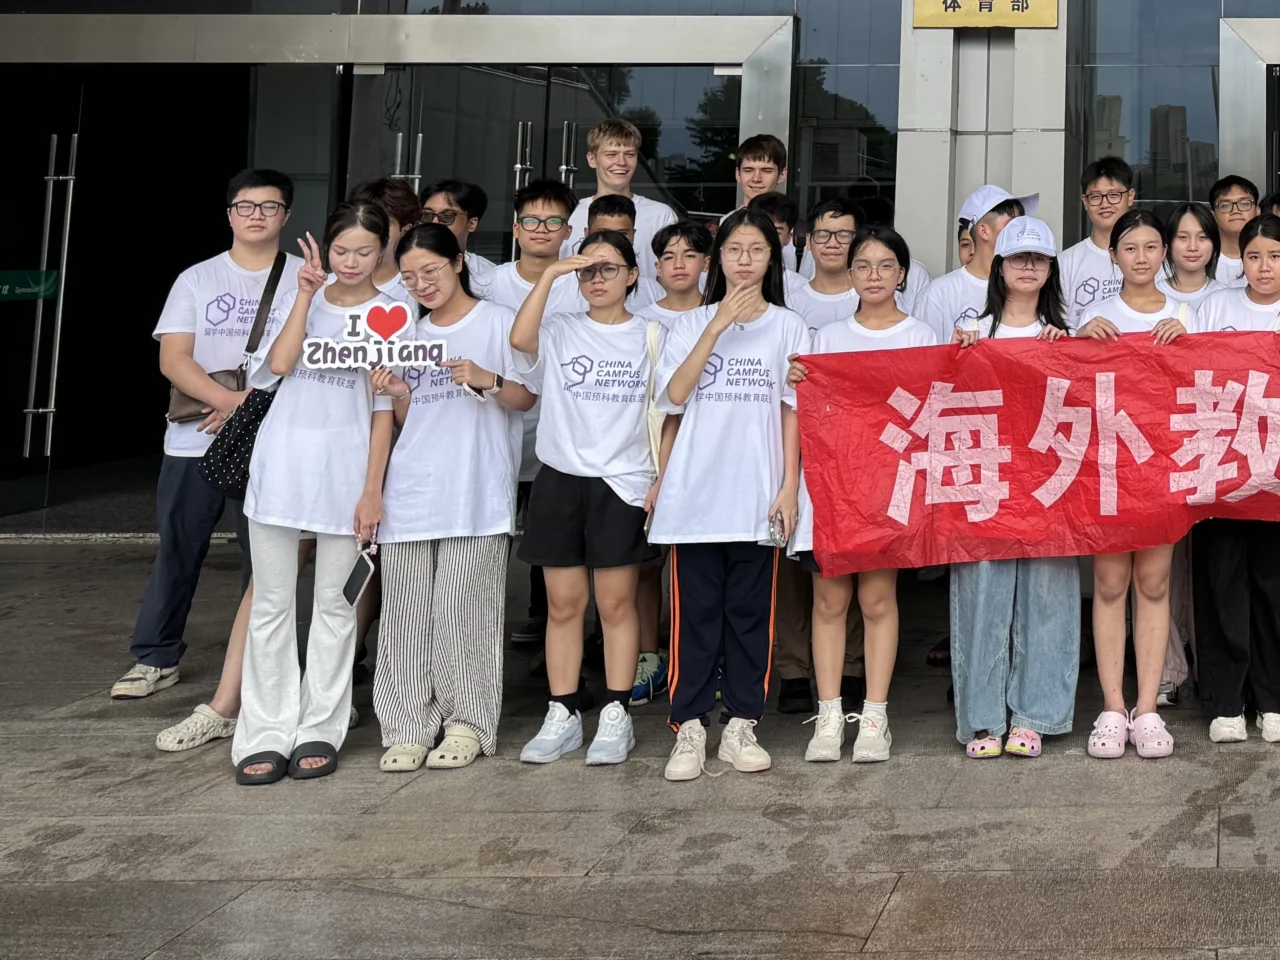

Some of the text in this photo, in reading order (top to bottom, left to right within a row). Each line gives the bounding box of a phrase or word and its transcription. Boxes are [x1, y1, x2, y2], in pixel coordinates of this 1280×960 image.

[1102, 279, 1122, 287] CHIN
[239, 298, 261, 306] CHIN
[347, 314, 361, 337] I
[307, 341, 444, 366] Zhenjiang
[598, 360, 632, 368] CHINA
[727, 358, 762, 366] CHINA
[596, 370, 641, 379] CAMPUS
[726, 368, 770, 378] CAMPUS
[594, 379, 648, 388] NETWORK
